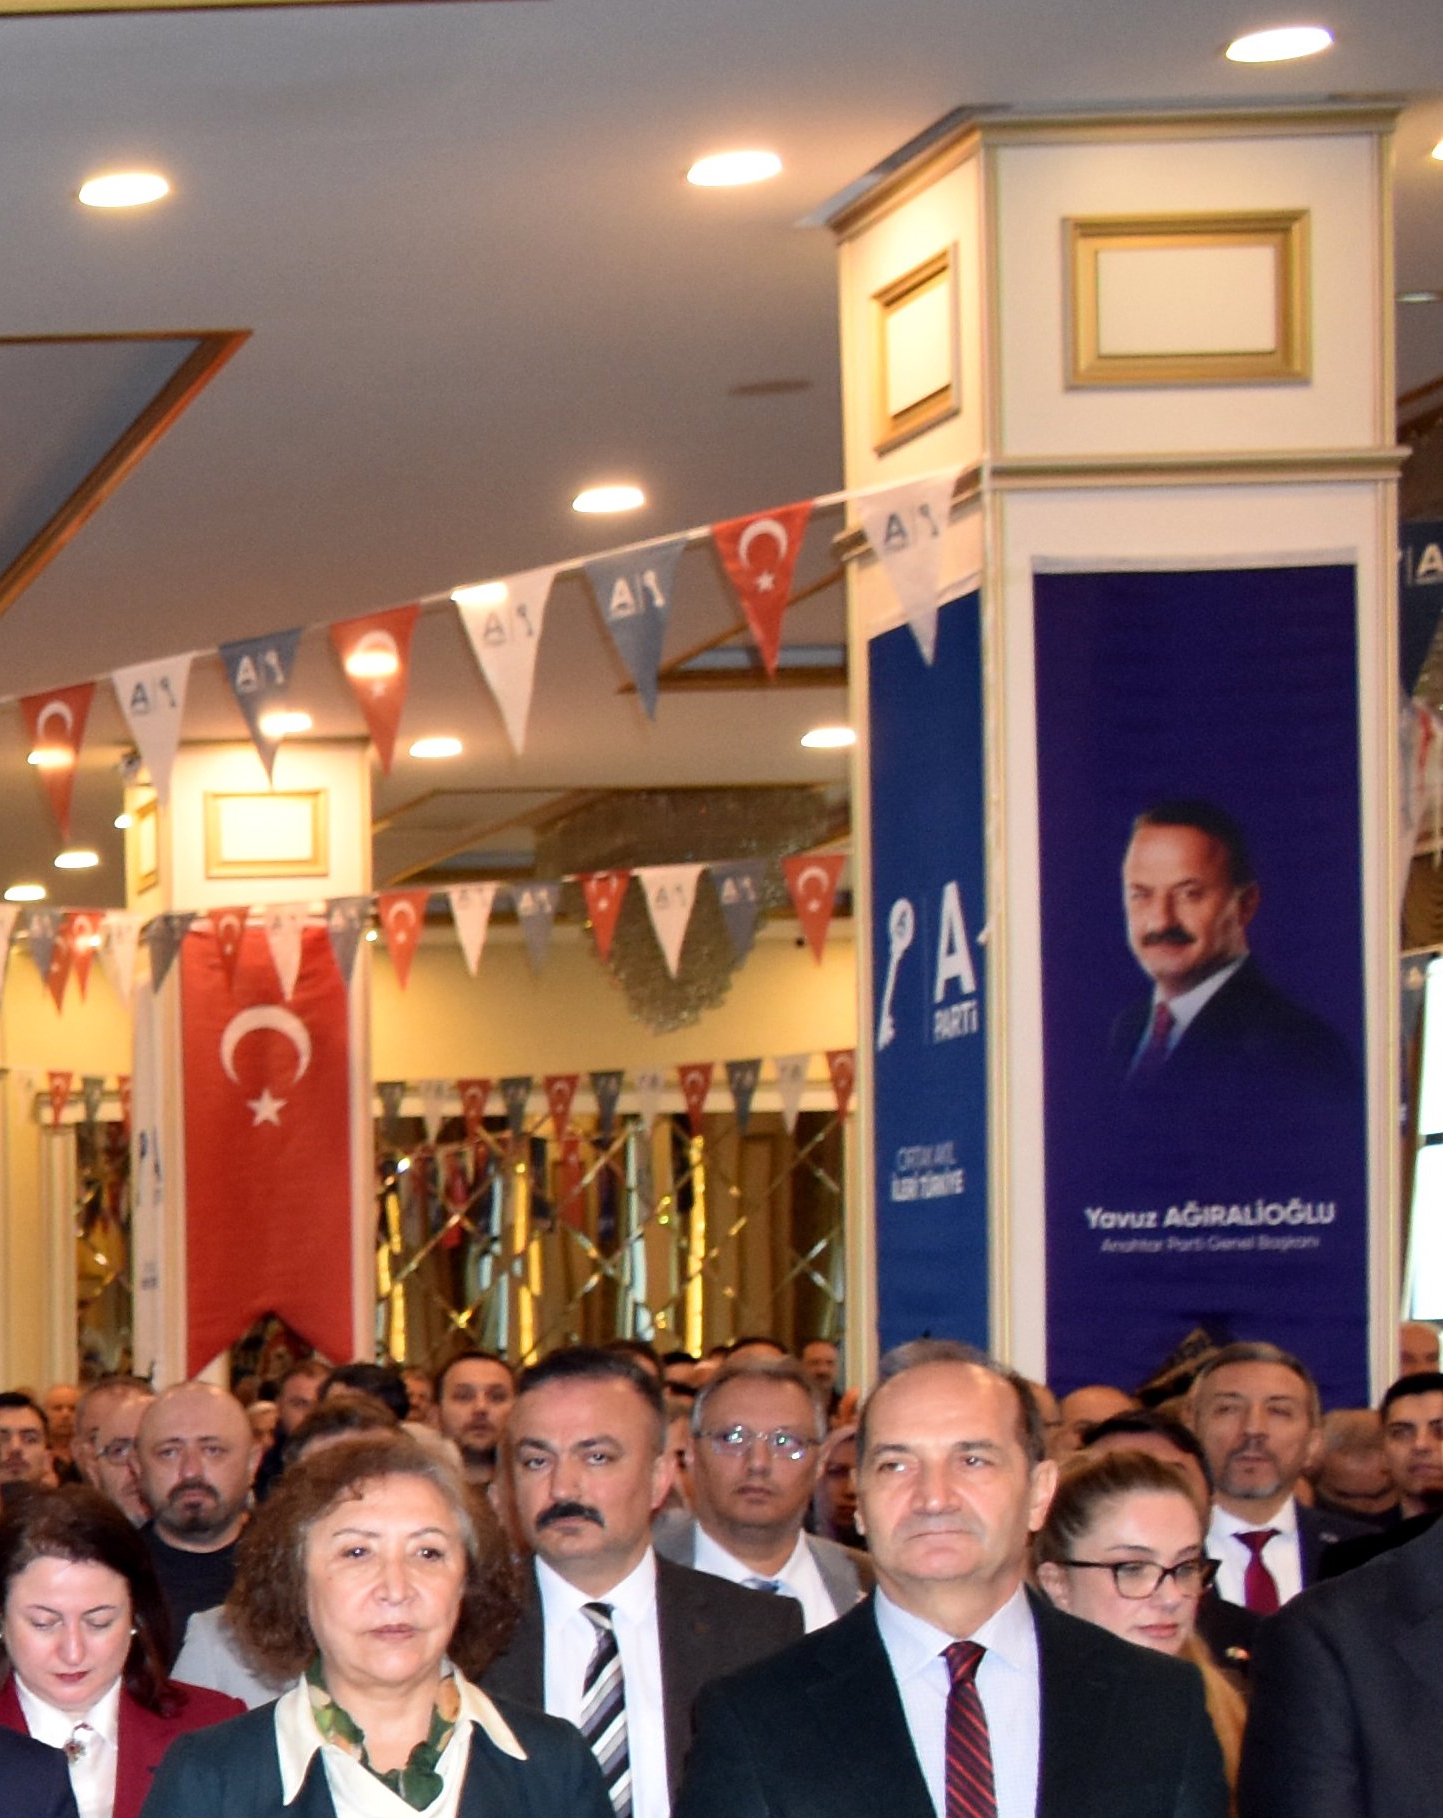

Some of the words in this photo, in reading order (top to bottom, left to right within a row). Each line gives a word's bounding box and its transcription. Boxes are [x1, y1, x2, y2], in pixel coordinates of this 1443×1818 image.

[885, 513, 907, 542] A
[611, 577, 631, 608] A
[483, 611, 505, 637] A
[236, 655, 256, 684] A
[130, 682, 150, 707] A
[934, 880, 977, 1003] A
[1085, 1207, 1157, 1228] Yavuz
[1164, 1197, 1336, 1227] AĞIRALİOĞLU
